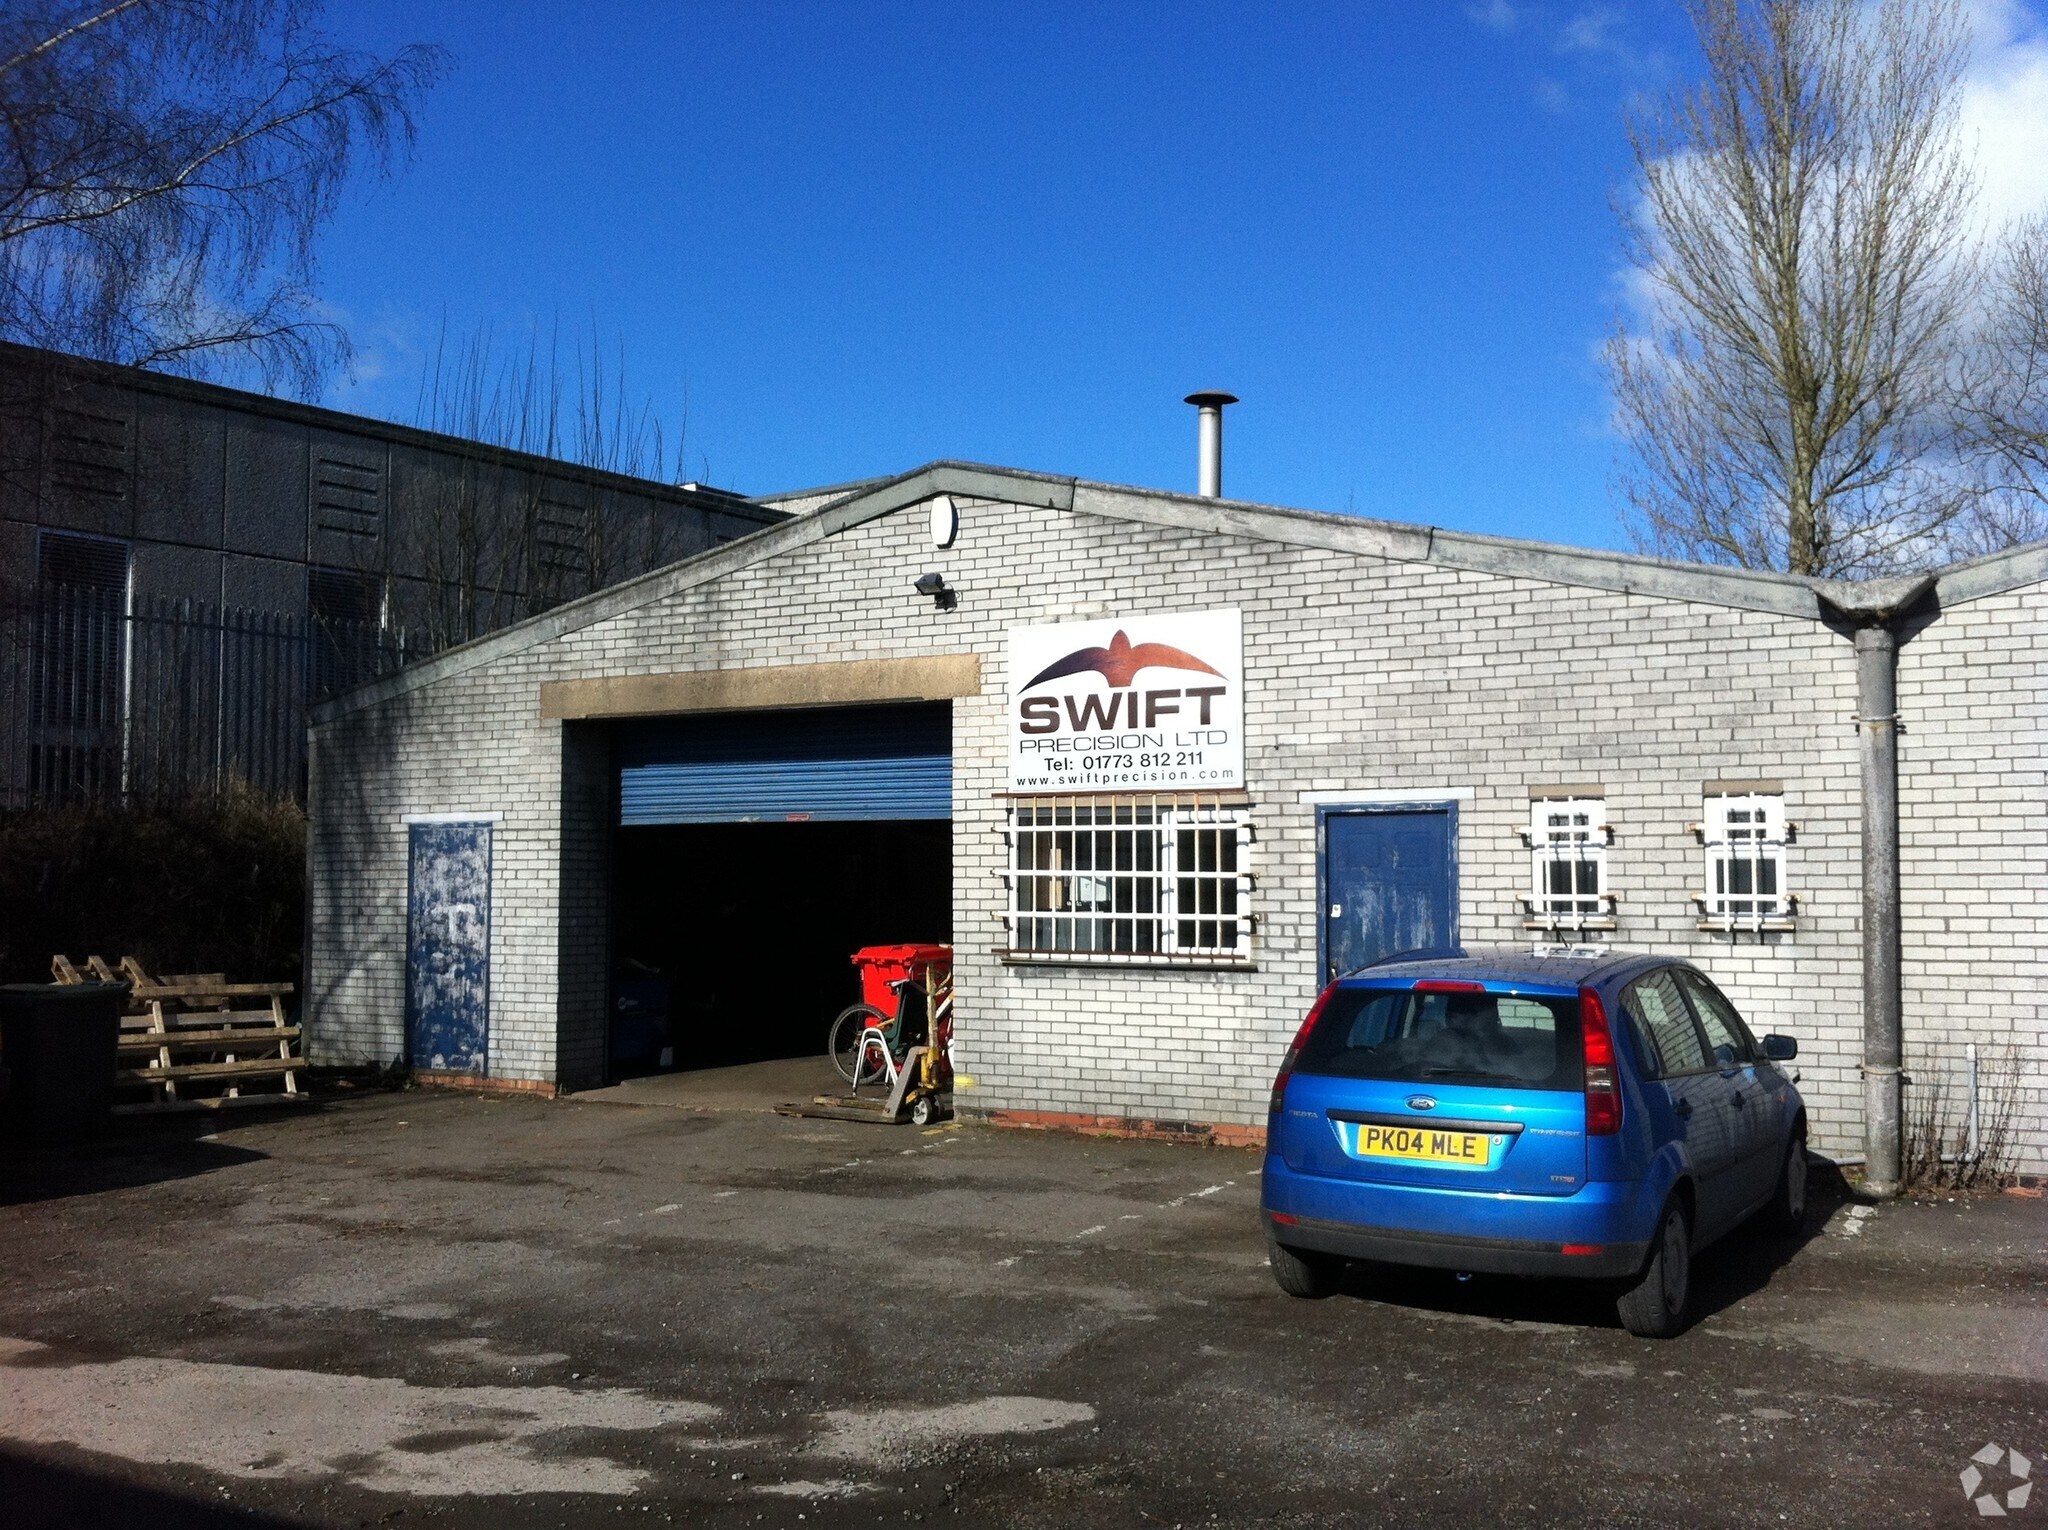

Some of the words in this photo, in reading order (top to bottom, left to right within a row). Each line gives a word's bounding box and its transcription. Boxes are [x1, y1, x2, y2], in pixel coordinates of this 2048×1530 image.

[1020, 686, 1226, 734] SWIFT
[1020, 733, 1163, 754] PRECISION
[1176, 730, 1228, 746] LTD
[1044, 757, 1074, 771] Tel:
[1083, 754, 1134, 770] 01773
[1140, 752, 1171, 767] 812
[1176, 751, 1203, 765] 211
[1016, 769, 1234, 786] www.swiftprecision.com
[1366, 1128, 1424, 1153] PK04
[1431, 1133, 1477, 1158] MLE
